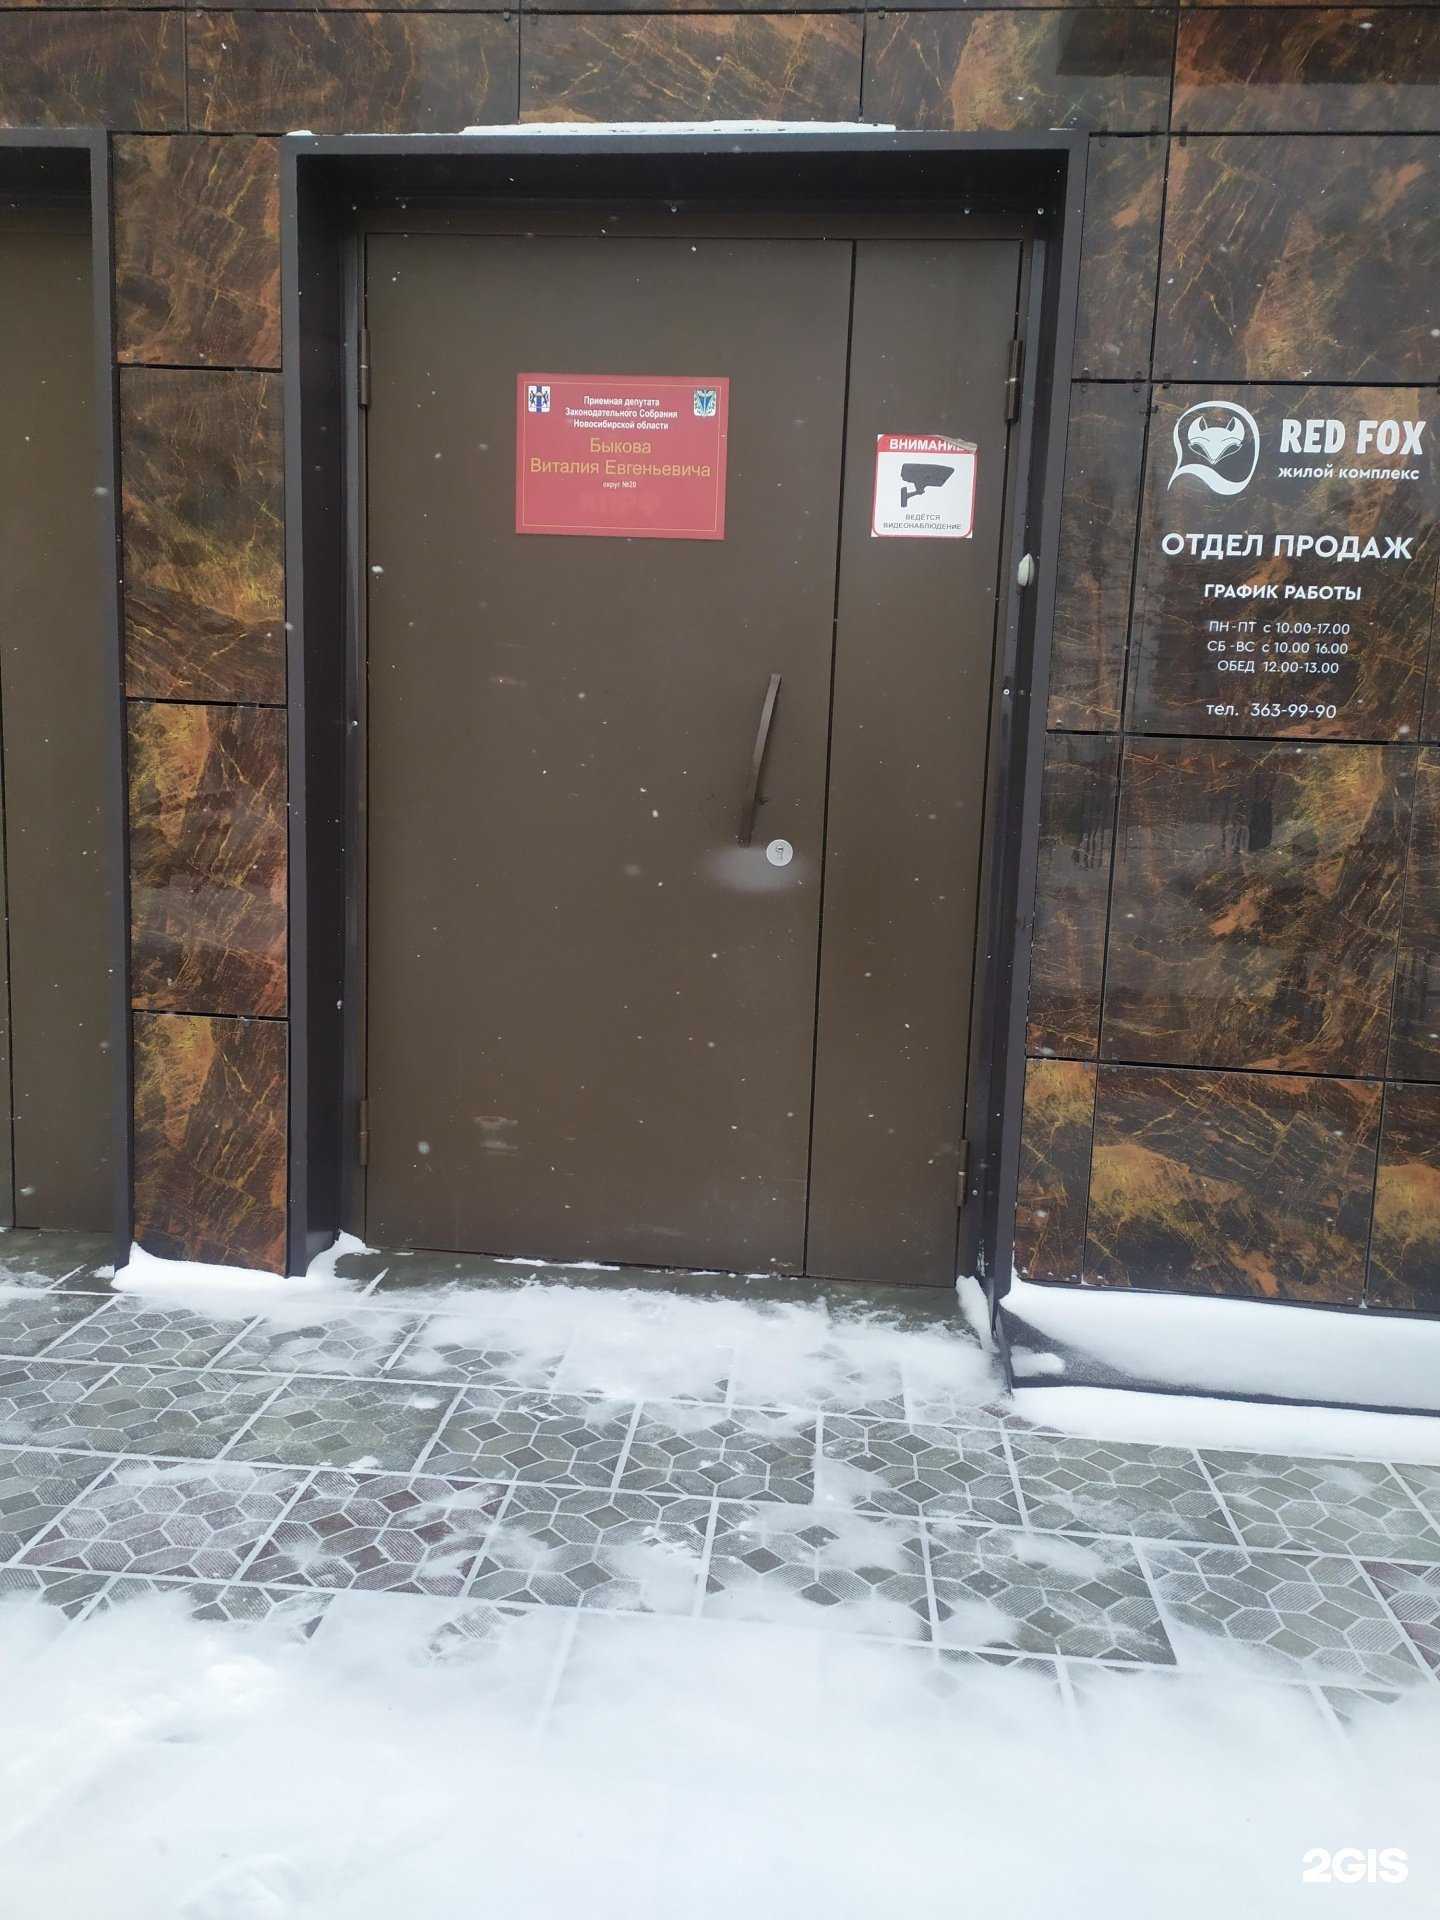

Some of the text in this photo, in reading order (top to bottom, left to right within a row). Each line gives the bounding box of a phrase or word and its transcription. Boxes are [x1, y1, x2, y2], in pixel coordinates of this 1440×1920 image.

[583, 395, 660, 408] Приемная депутата
[564, 407, 678, 419] Законодательного Собрания
[573, 419, 669, 430] Новосибирской области
[1279, 418, 1427, 455] RED FOX
[590, 437, 651, 454] Быкова
[530, 457, 711, 477] Виталия Евгеньевича
[1277, 464, 1420, 481] жилой комплекс
[602, 481, 620, 489] округ
[883, 522, 961, 530] ВИДЕОНАБЛЮДЕНИЕ
[1161, 532, 1415, 562] ОТДЕЛ ПРОДАЖ
[1204, 583, 1362, 600] ГРАФИК РАБОТЫ
[1275, 622, 1350, 635] 10.00-17.00
[1217, 660, 1339, 674] ОБЕД 12.00-13.00
[1206, 703, 1337, 718] тел. 363-99-90
